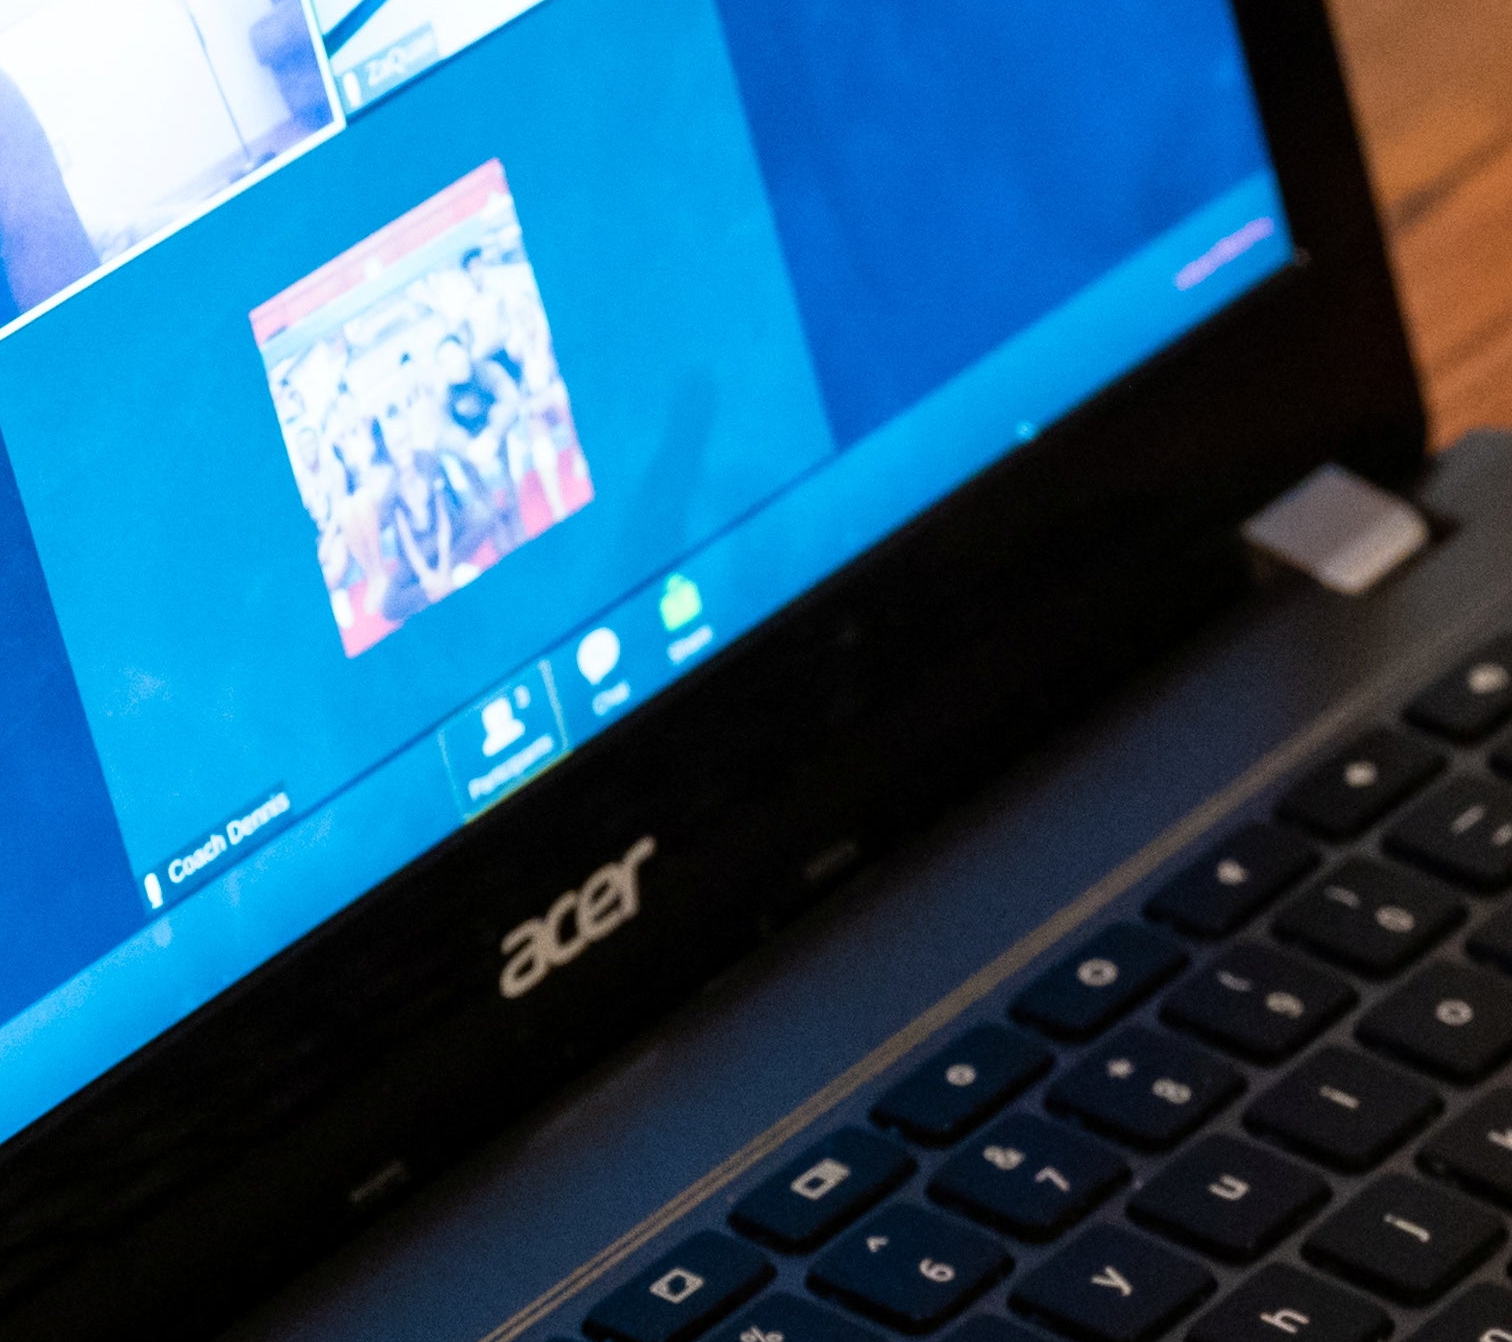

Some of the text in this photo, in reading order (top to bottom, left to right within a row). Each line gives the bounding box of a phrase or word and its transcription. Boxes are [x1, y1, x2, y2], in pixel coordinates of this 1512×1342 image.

[168, 792, 290, 883] Coach Dennis
[500, 837, 655, 998] acer
[1436, 1000, 1473, 1025] o
[1035, 1166, 1070, 1192] 7
[1209, 1175, 1249, 1201] u
[919, 1258, 955, 1283] 6
[1092, 1266, 1132, 1296] y
[1260, 1308, 1309, 1334] h
